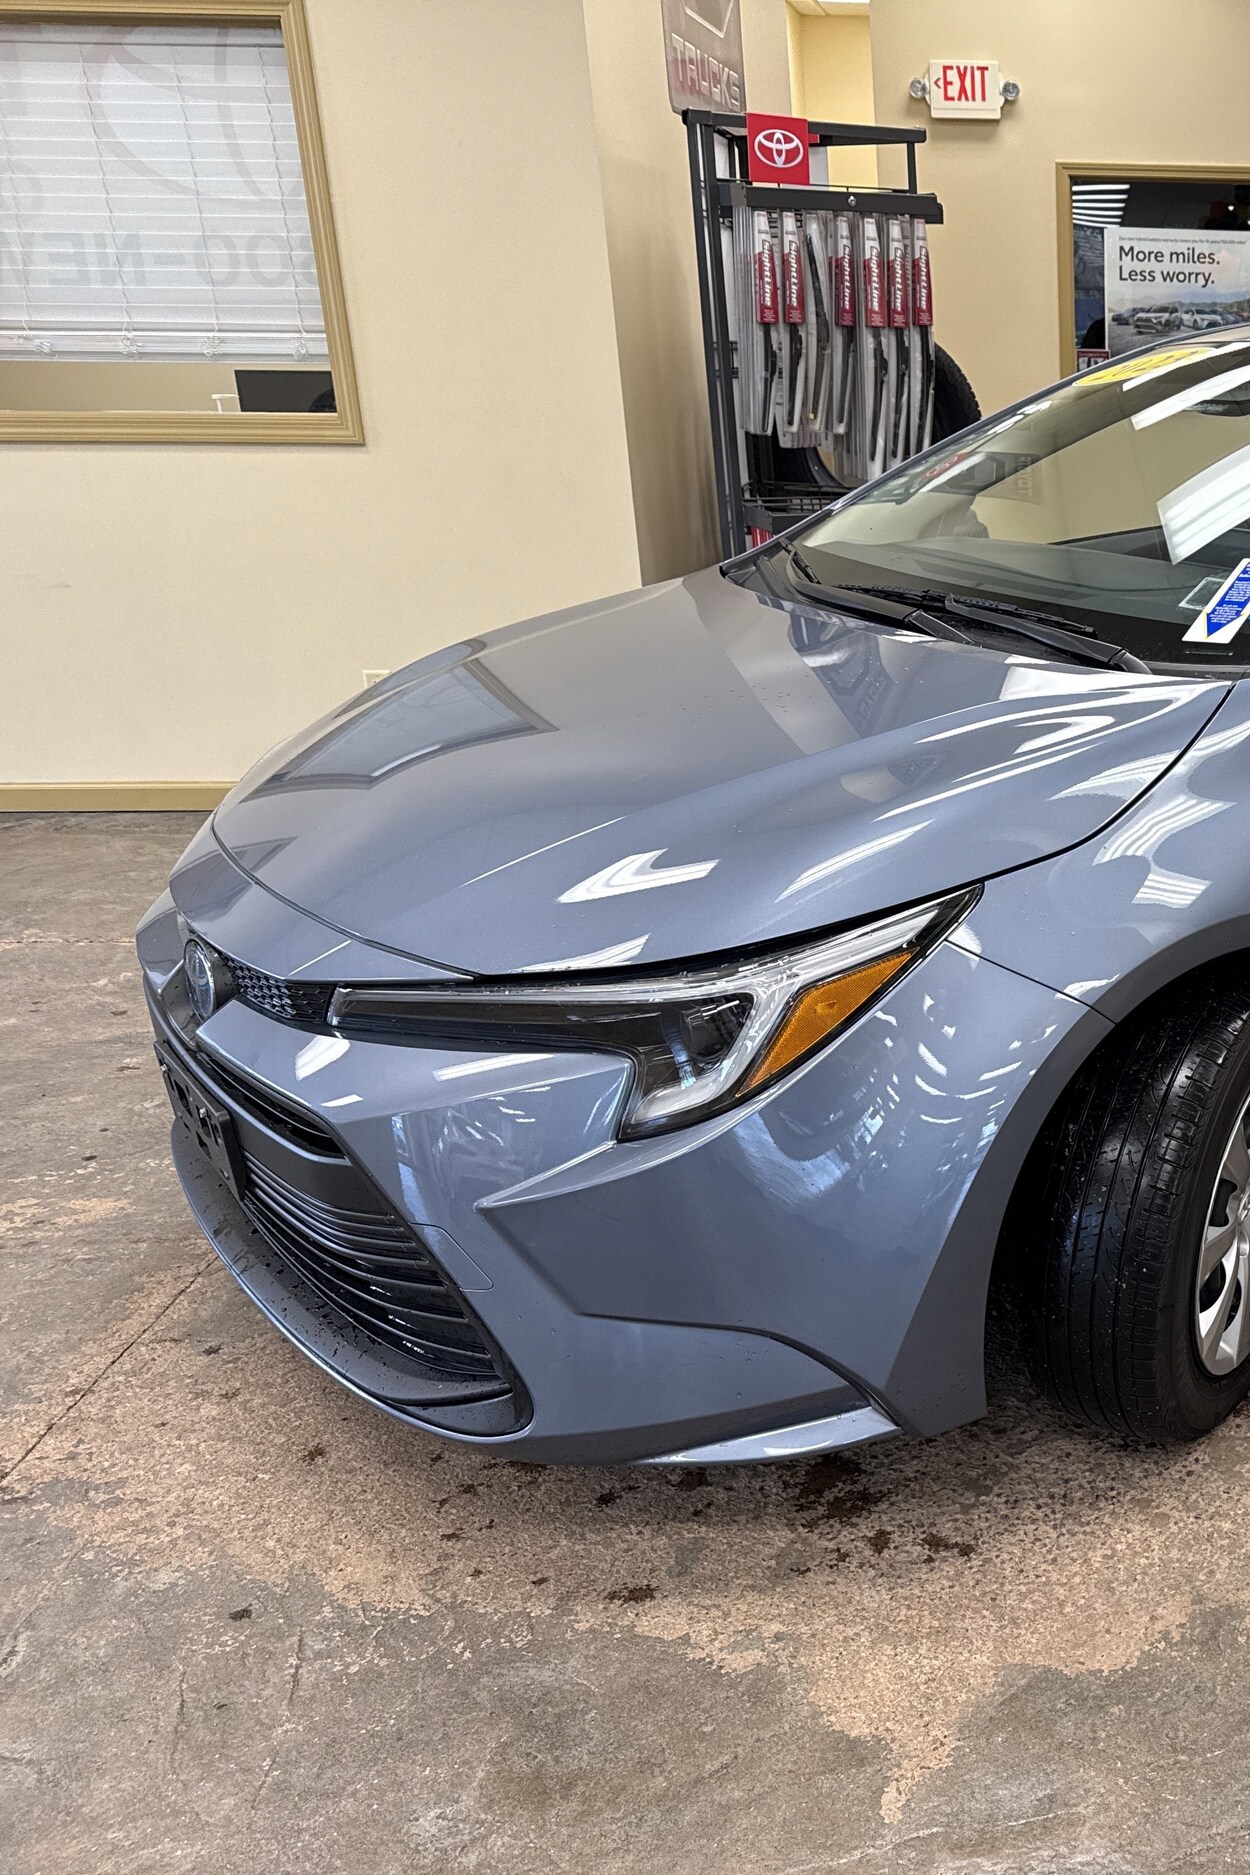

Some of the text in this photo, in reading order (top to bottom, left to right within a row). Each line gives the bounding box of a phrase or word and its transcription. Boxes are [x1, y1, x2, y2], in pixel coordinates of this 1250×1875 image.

[671, 32, 740, 111] TRUCKS
[942, 65, 989, 102] EXIT
[1119, 245, 1220, 265] More miles.
[1119, 265, 1215, 288] Less worry.
